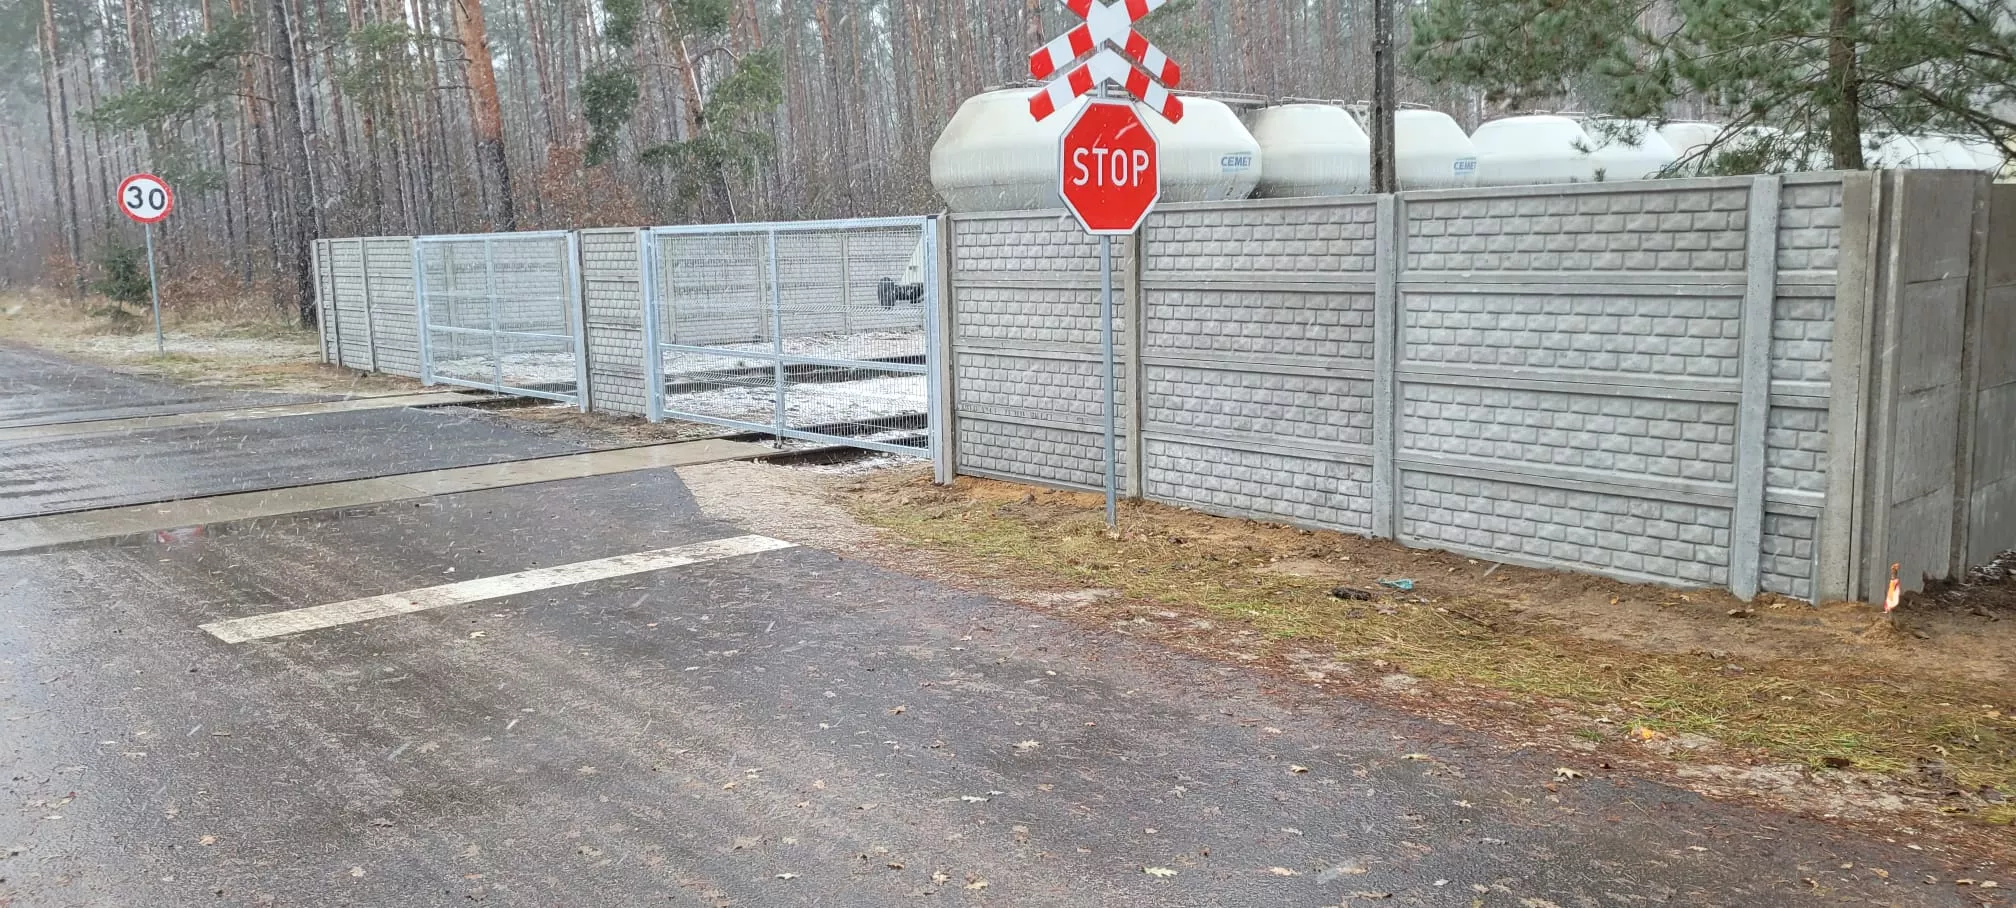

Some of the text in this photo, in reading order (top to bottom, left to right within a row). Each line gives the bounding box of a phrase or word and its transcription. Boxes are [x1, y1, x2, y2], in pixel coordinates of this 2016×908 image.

[1073, 147, 1149, 187] STOP
[1221, 156, 1252, 167] CEMET
[127, 186, 165, 210] 30
